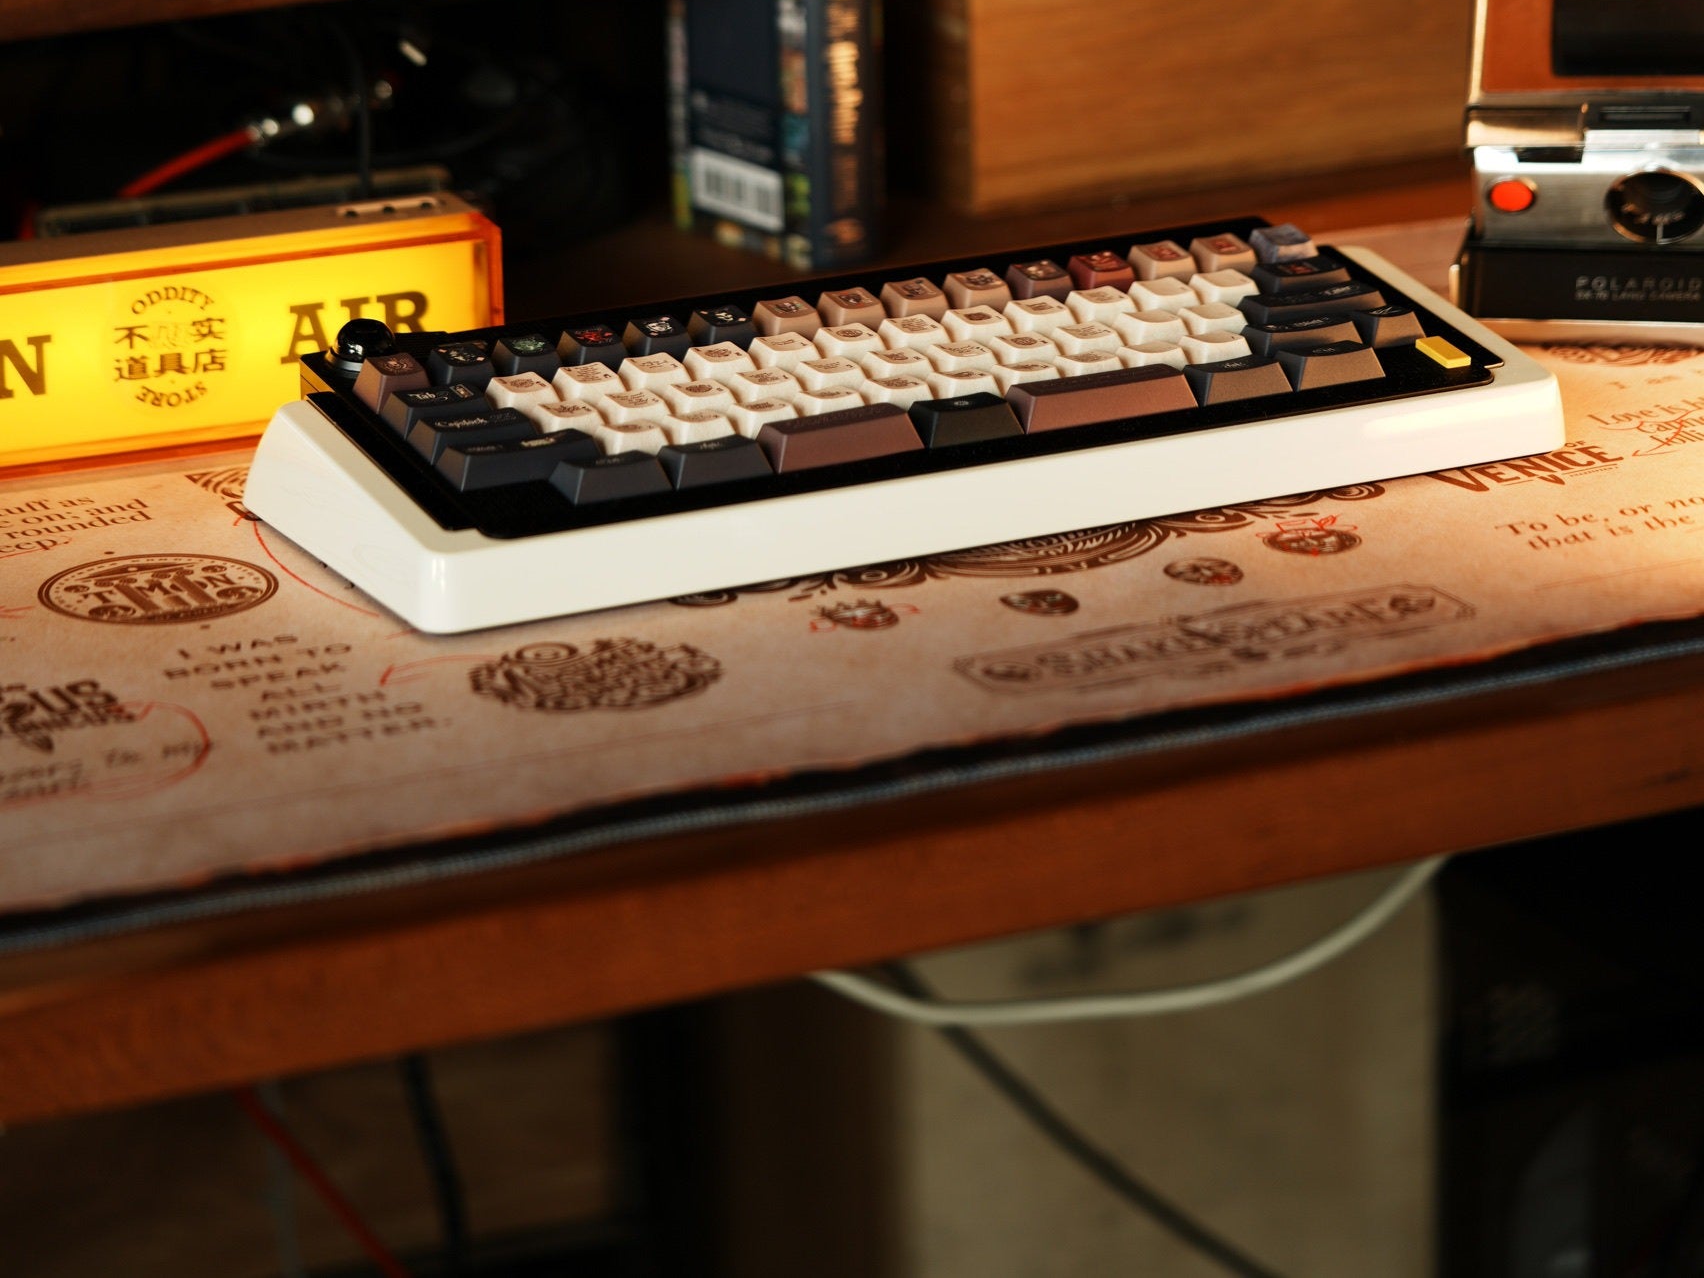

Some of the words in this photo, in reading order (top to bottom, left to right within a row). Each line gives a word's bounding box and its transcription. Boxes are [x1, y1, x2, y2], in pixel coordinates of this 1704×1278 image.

[1575, 276, 1702, 291] POLAROID
[131, 286, 215, 315] ODDITY
[114, 348, 227, 383] 道具店
[135, 381, 208, 407] STORE
[1564, 439, 1588, 449] OF
[1426, 444, 1625, 493] VENICE
[58, 497, 95, 508] as
[85, 498, 149, 516] and
[5, 510, 153, 539] rounded
[1494, 520, 1549, 536] To
[1619, 503, 1652, 518] or
[1527, 529, 1596, 551] that
[1607, 522, 1634, 537] is
[1644, 513, 1697, 531] the
[163, 654, 282, 681] BORN
[296, 642, 352, 658] TO
[177, 648, 191, 660] I
[206, 635, 299, 656] WAS
[210, 661, 346, 691] SPEAK
